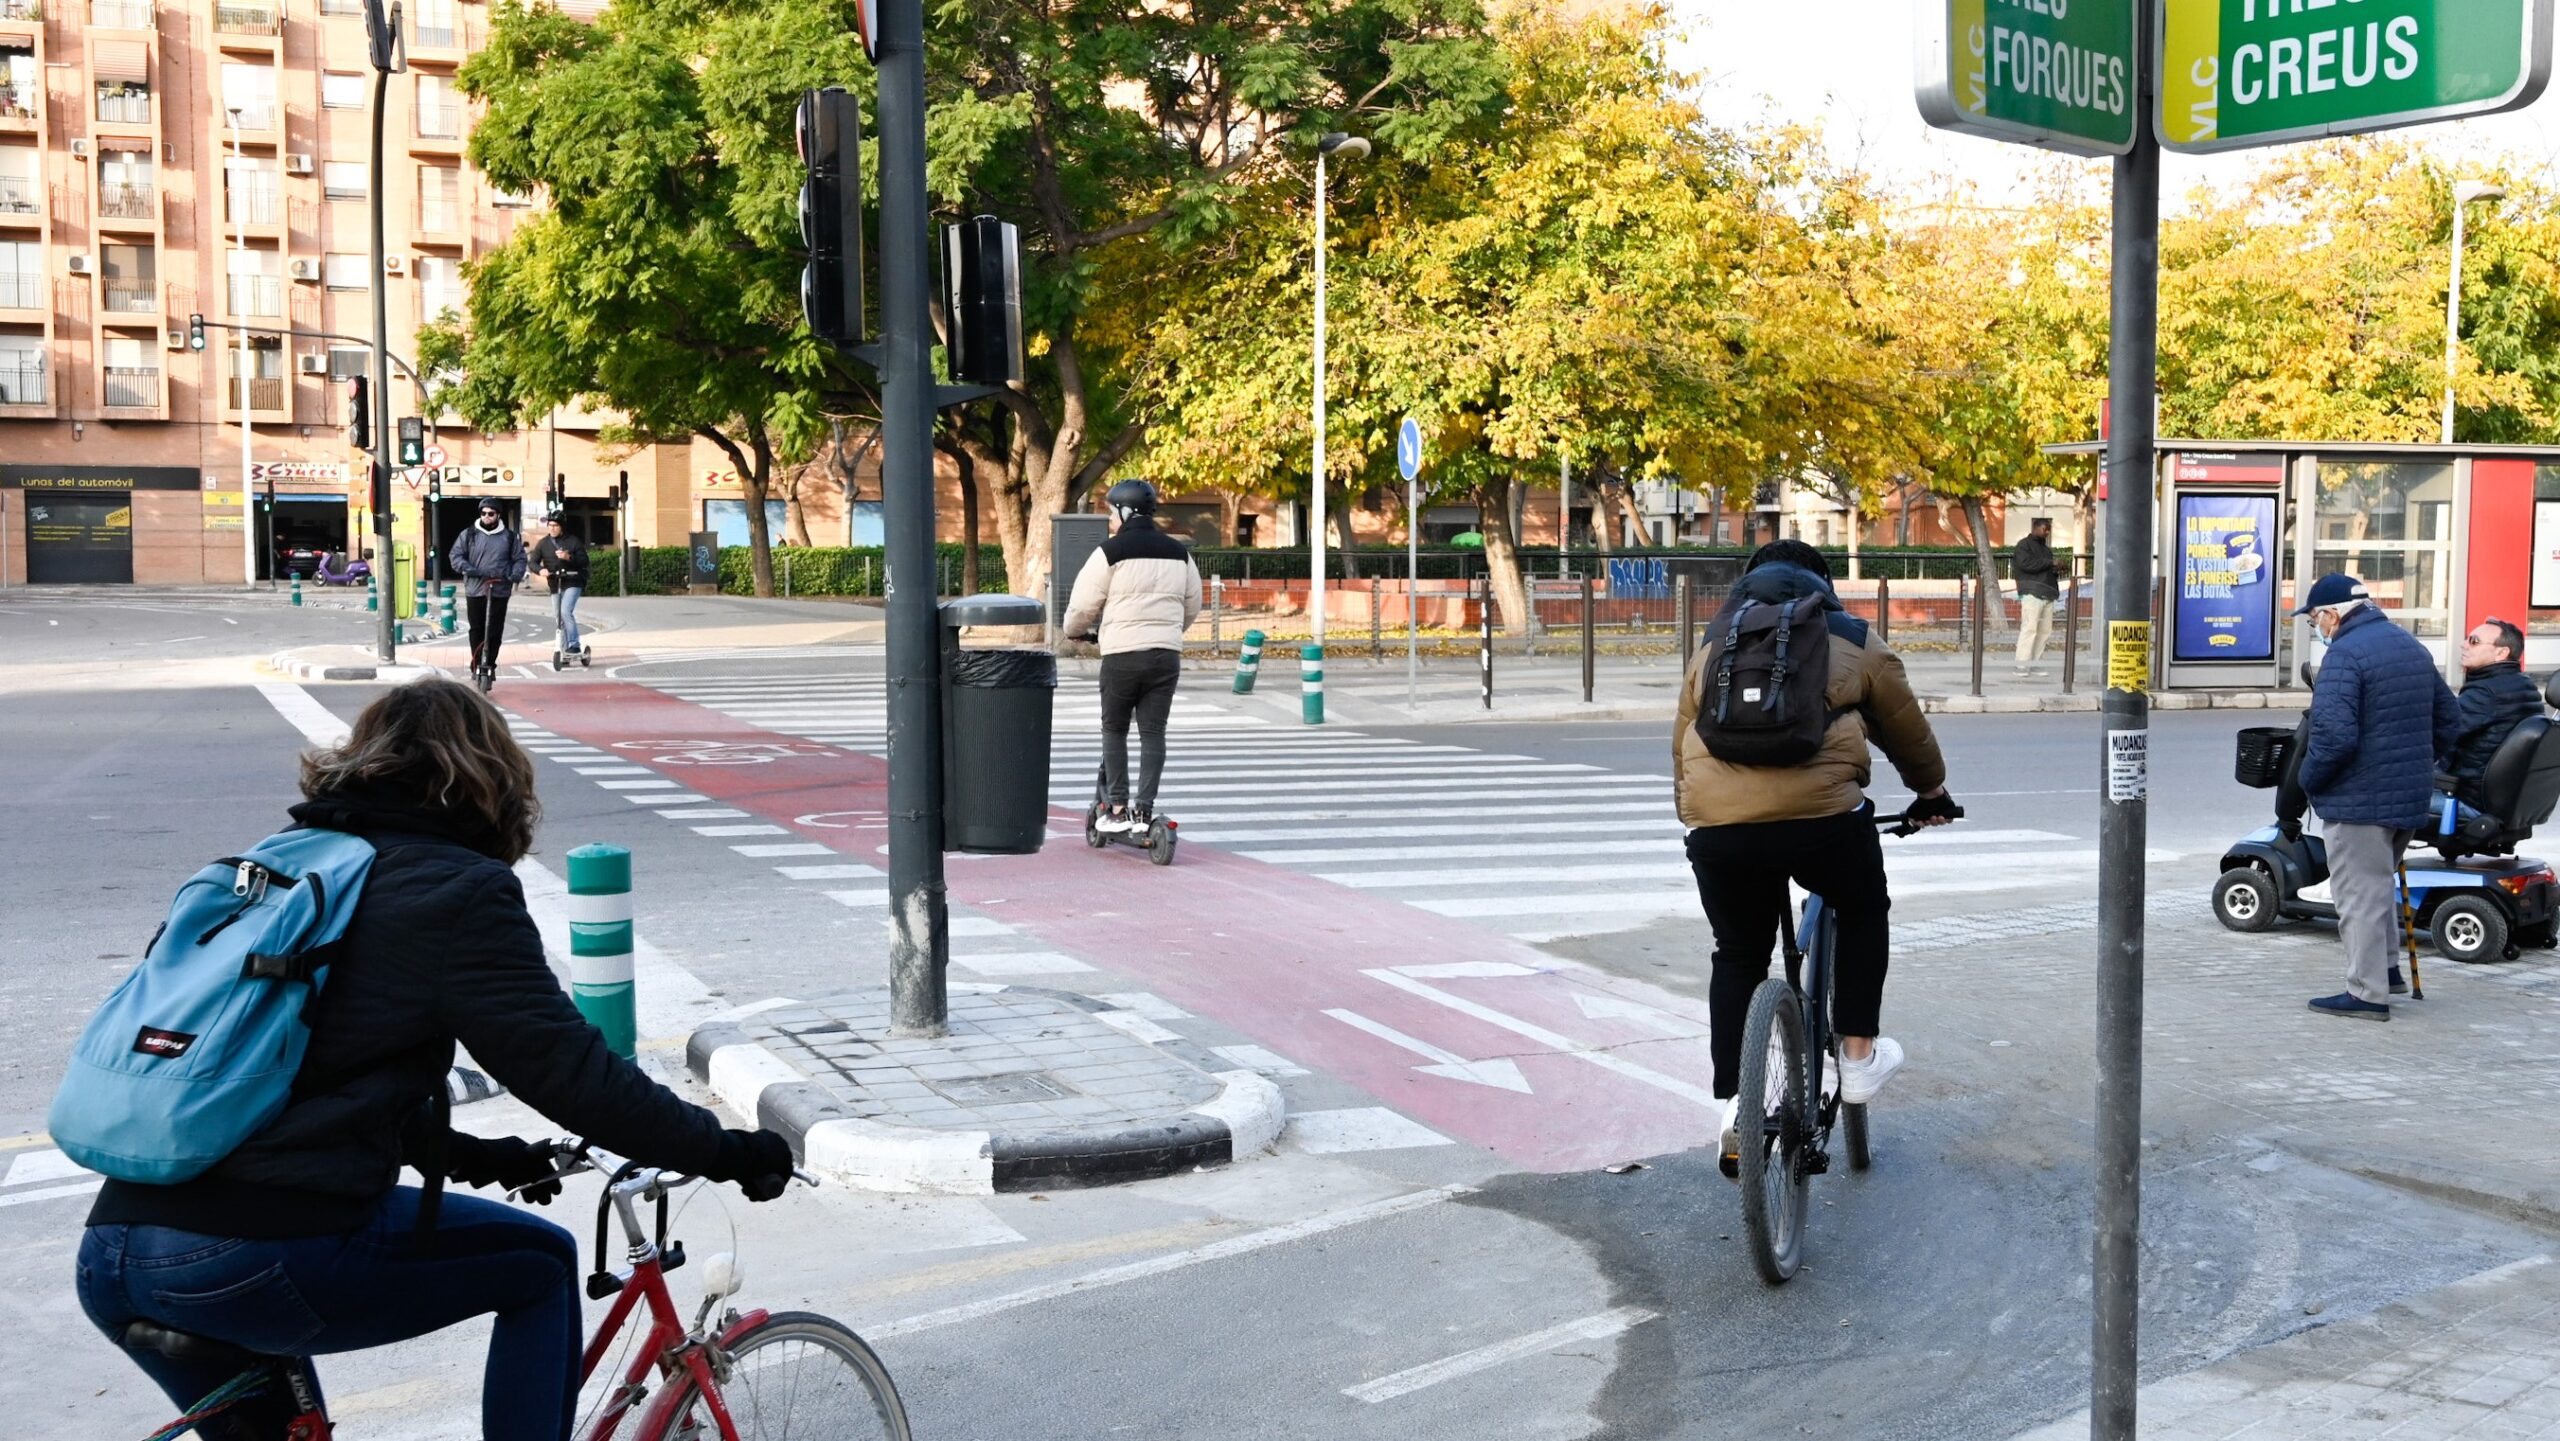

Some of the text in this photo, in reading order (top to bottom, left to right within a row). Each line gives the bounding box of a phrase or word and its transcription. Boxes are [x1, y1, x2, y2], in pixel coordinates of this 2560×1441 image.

[1968, 24, 1986, 112] VLC
[2231, 16, 2418, 105] CREUS
[1993, 26, 2124, 115] FORQUES
[2190, 56, 2219, 141] VLC
[251, 463, 338, 481] 3 Cruces
[21, 477, 134, 488] Lunas del automóvil
[2186, 517, 2257, 532] LO IMPORTANTE
[2186, 531, 2213, 545] NO ES
[2186, 544, 2228, 559] PONERSE
[2186, 558, 2196, 571] EL
[2185, 571, 2239, 585] ES PONERSE
[2184, 585, 2234, 599] LAS BOTAS.
[2112, 626, 2148, 642] MUDANZAS
